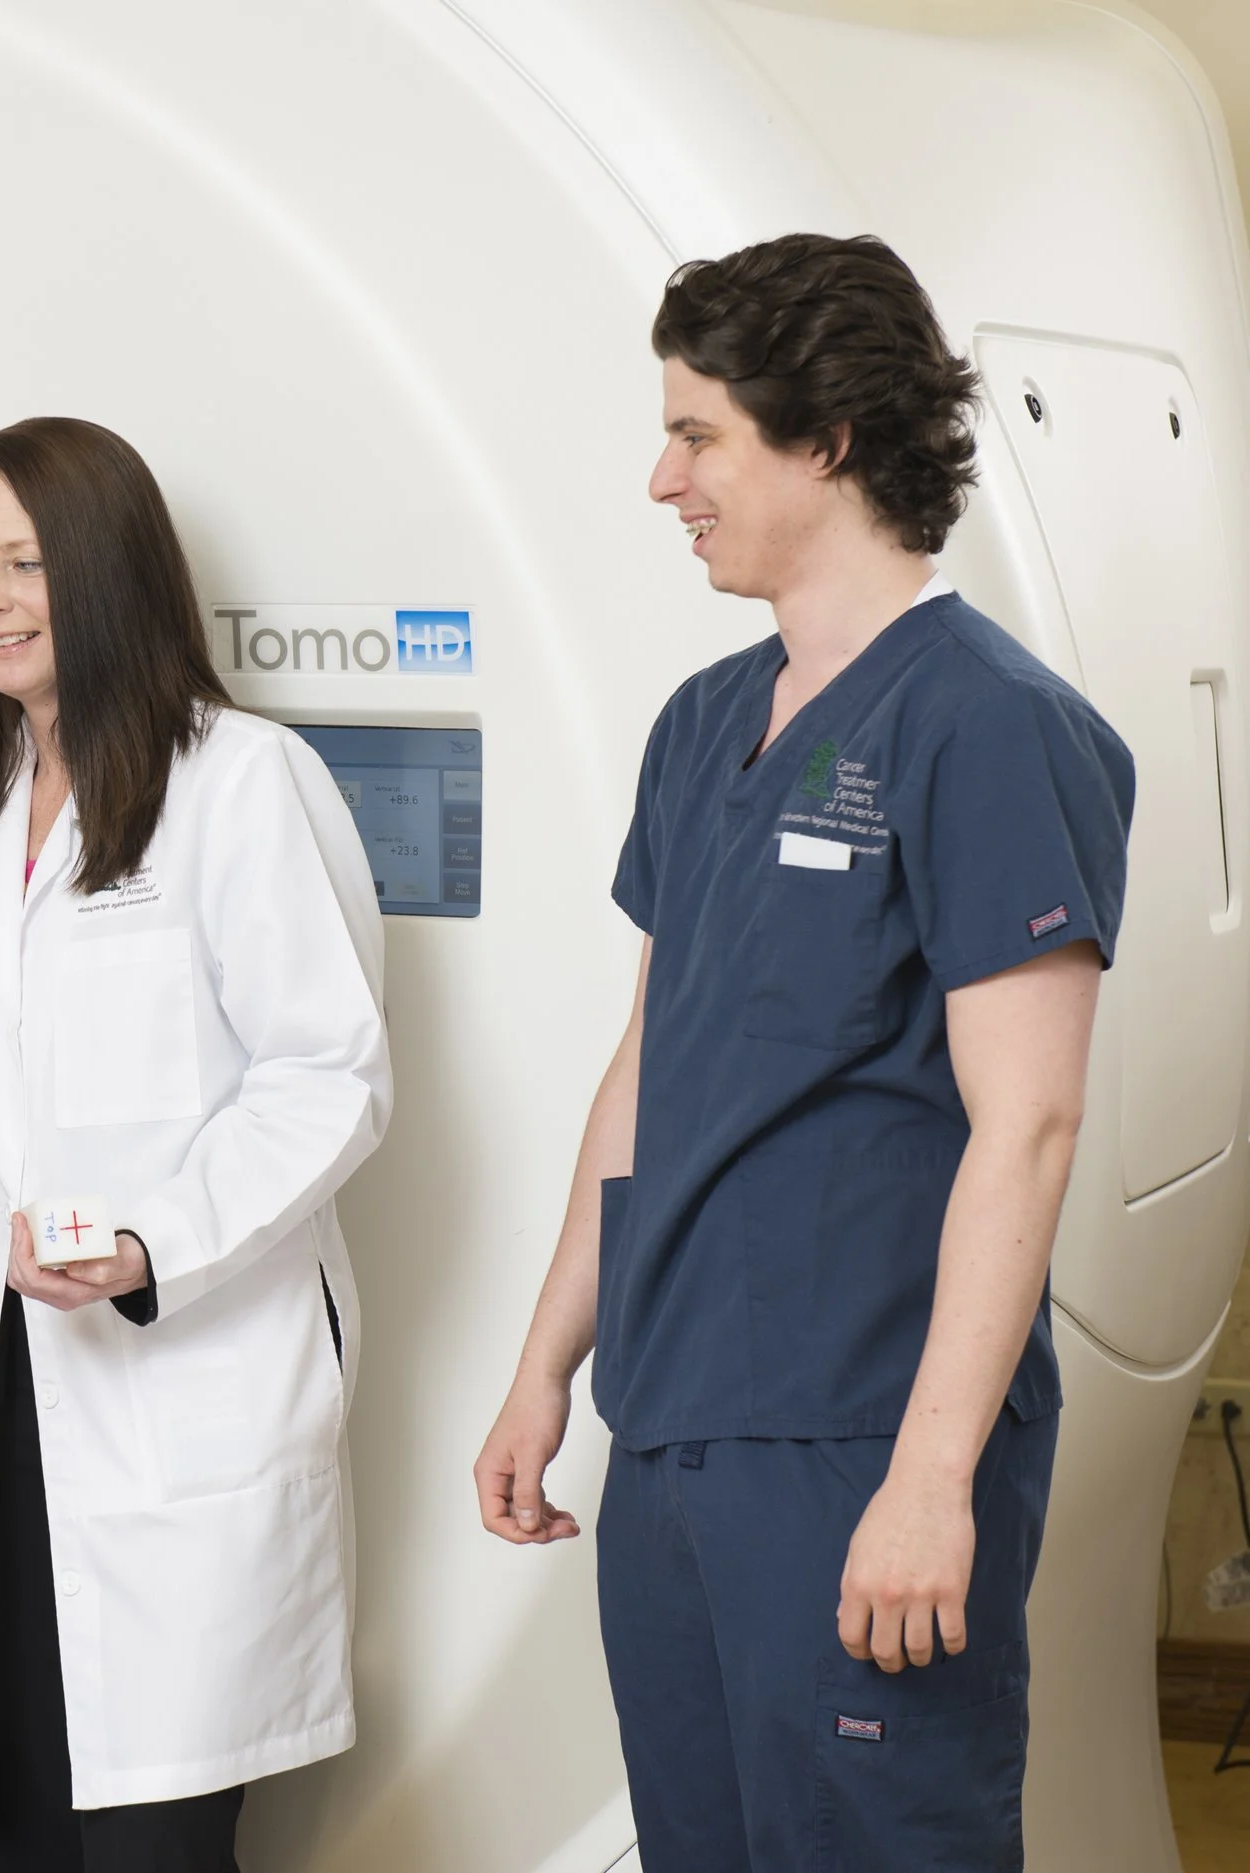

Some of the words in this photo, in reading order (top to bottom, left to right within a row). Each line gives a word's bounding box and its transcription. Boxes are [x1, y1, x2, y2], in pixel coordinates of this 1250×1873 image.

[214, 609, 391, 672] Tomo
[403, 623, 465, 662] HD
[390, 795, 419, 805] +89.6
[833, 786, 873, 805] Centers
[390, 845, 419, 856] +23.8
[122, 877, 147, 888] Centers
